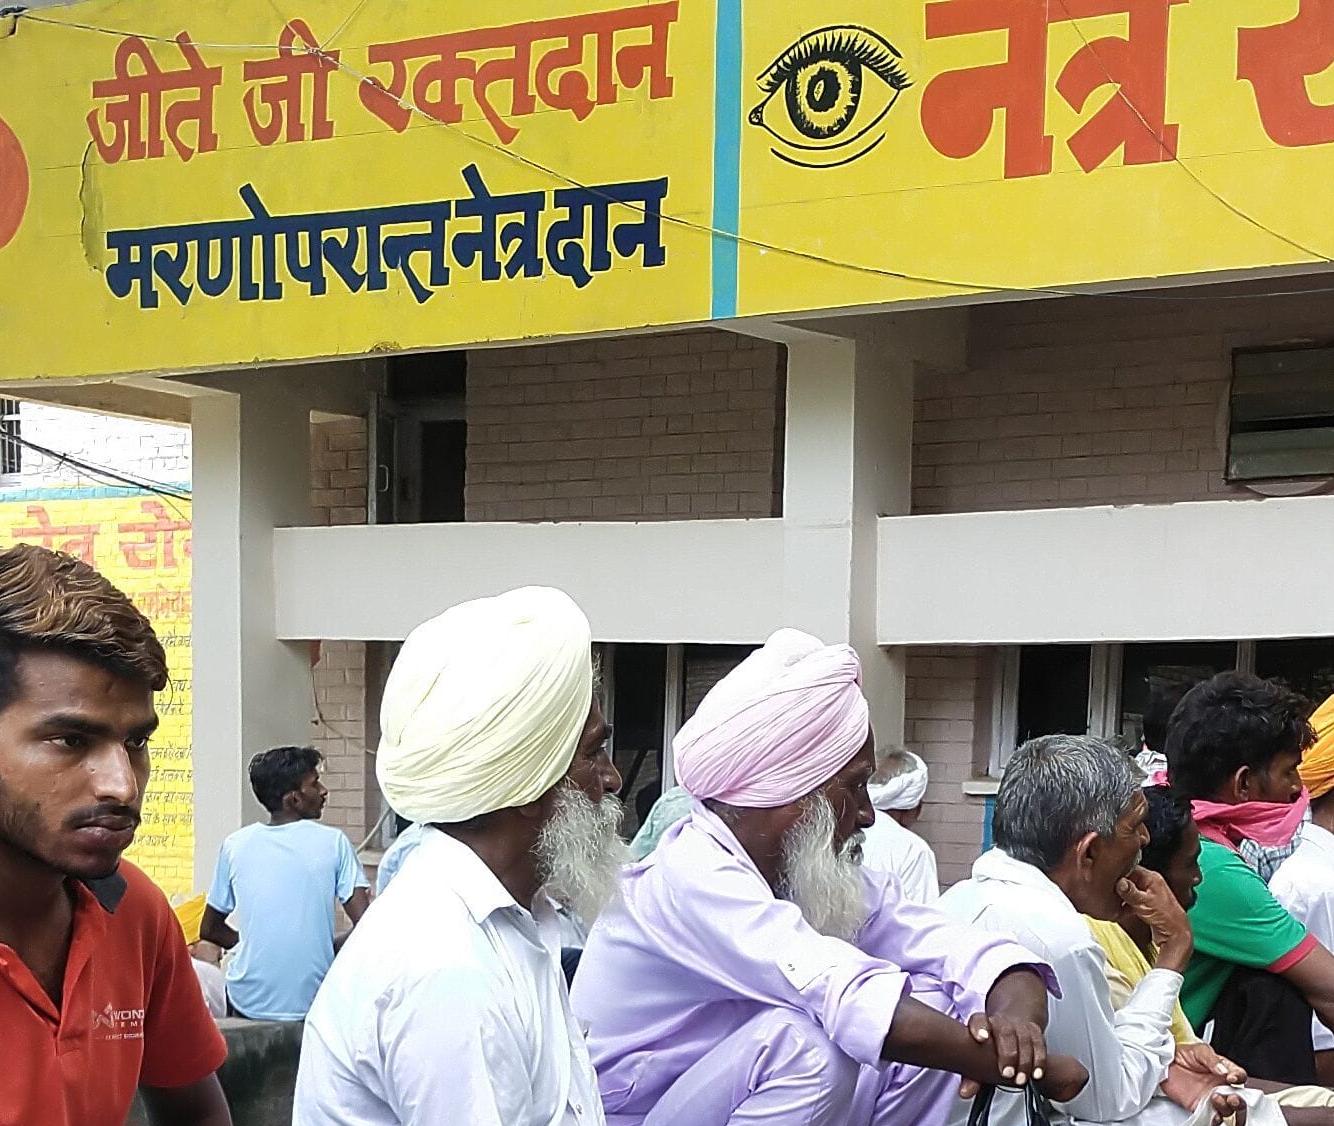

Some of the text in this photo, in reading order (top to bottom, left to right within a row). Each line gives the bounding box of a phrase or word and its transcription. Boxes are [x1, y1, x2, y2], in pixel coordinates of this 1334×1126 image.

[86, 0, 680, 164] जीते जी रक्तदान
